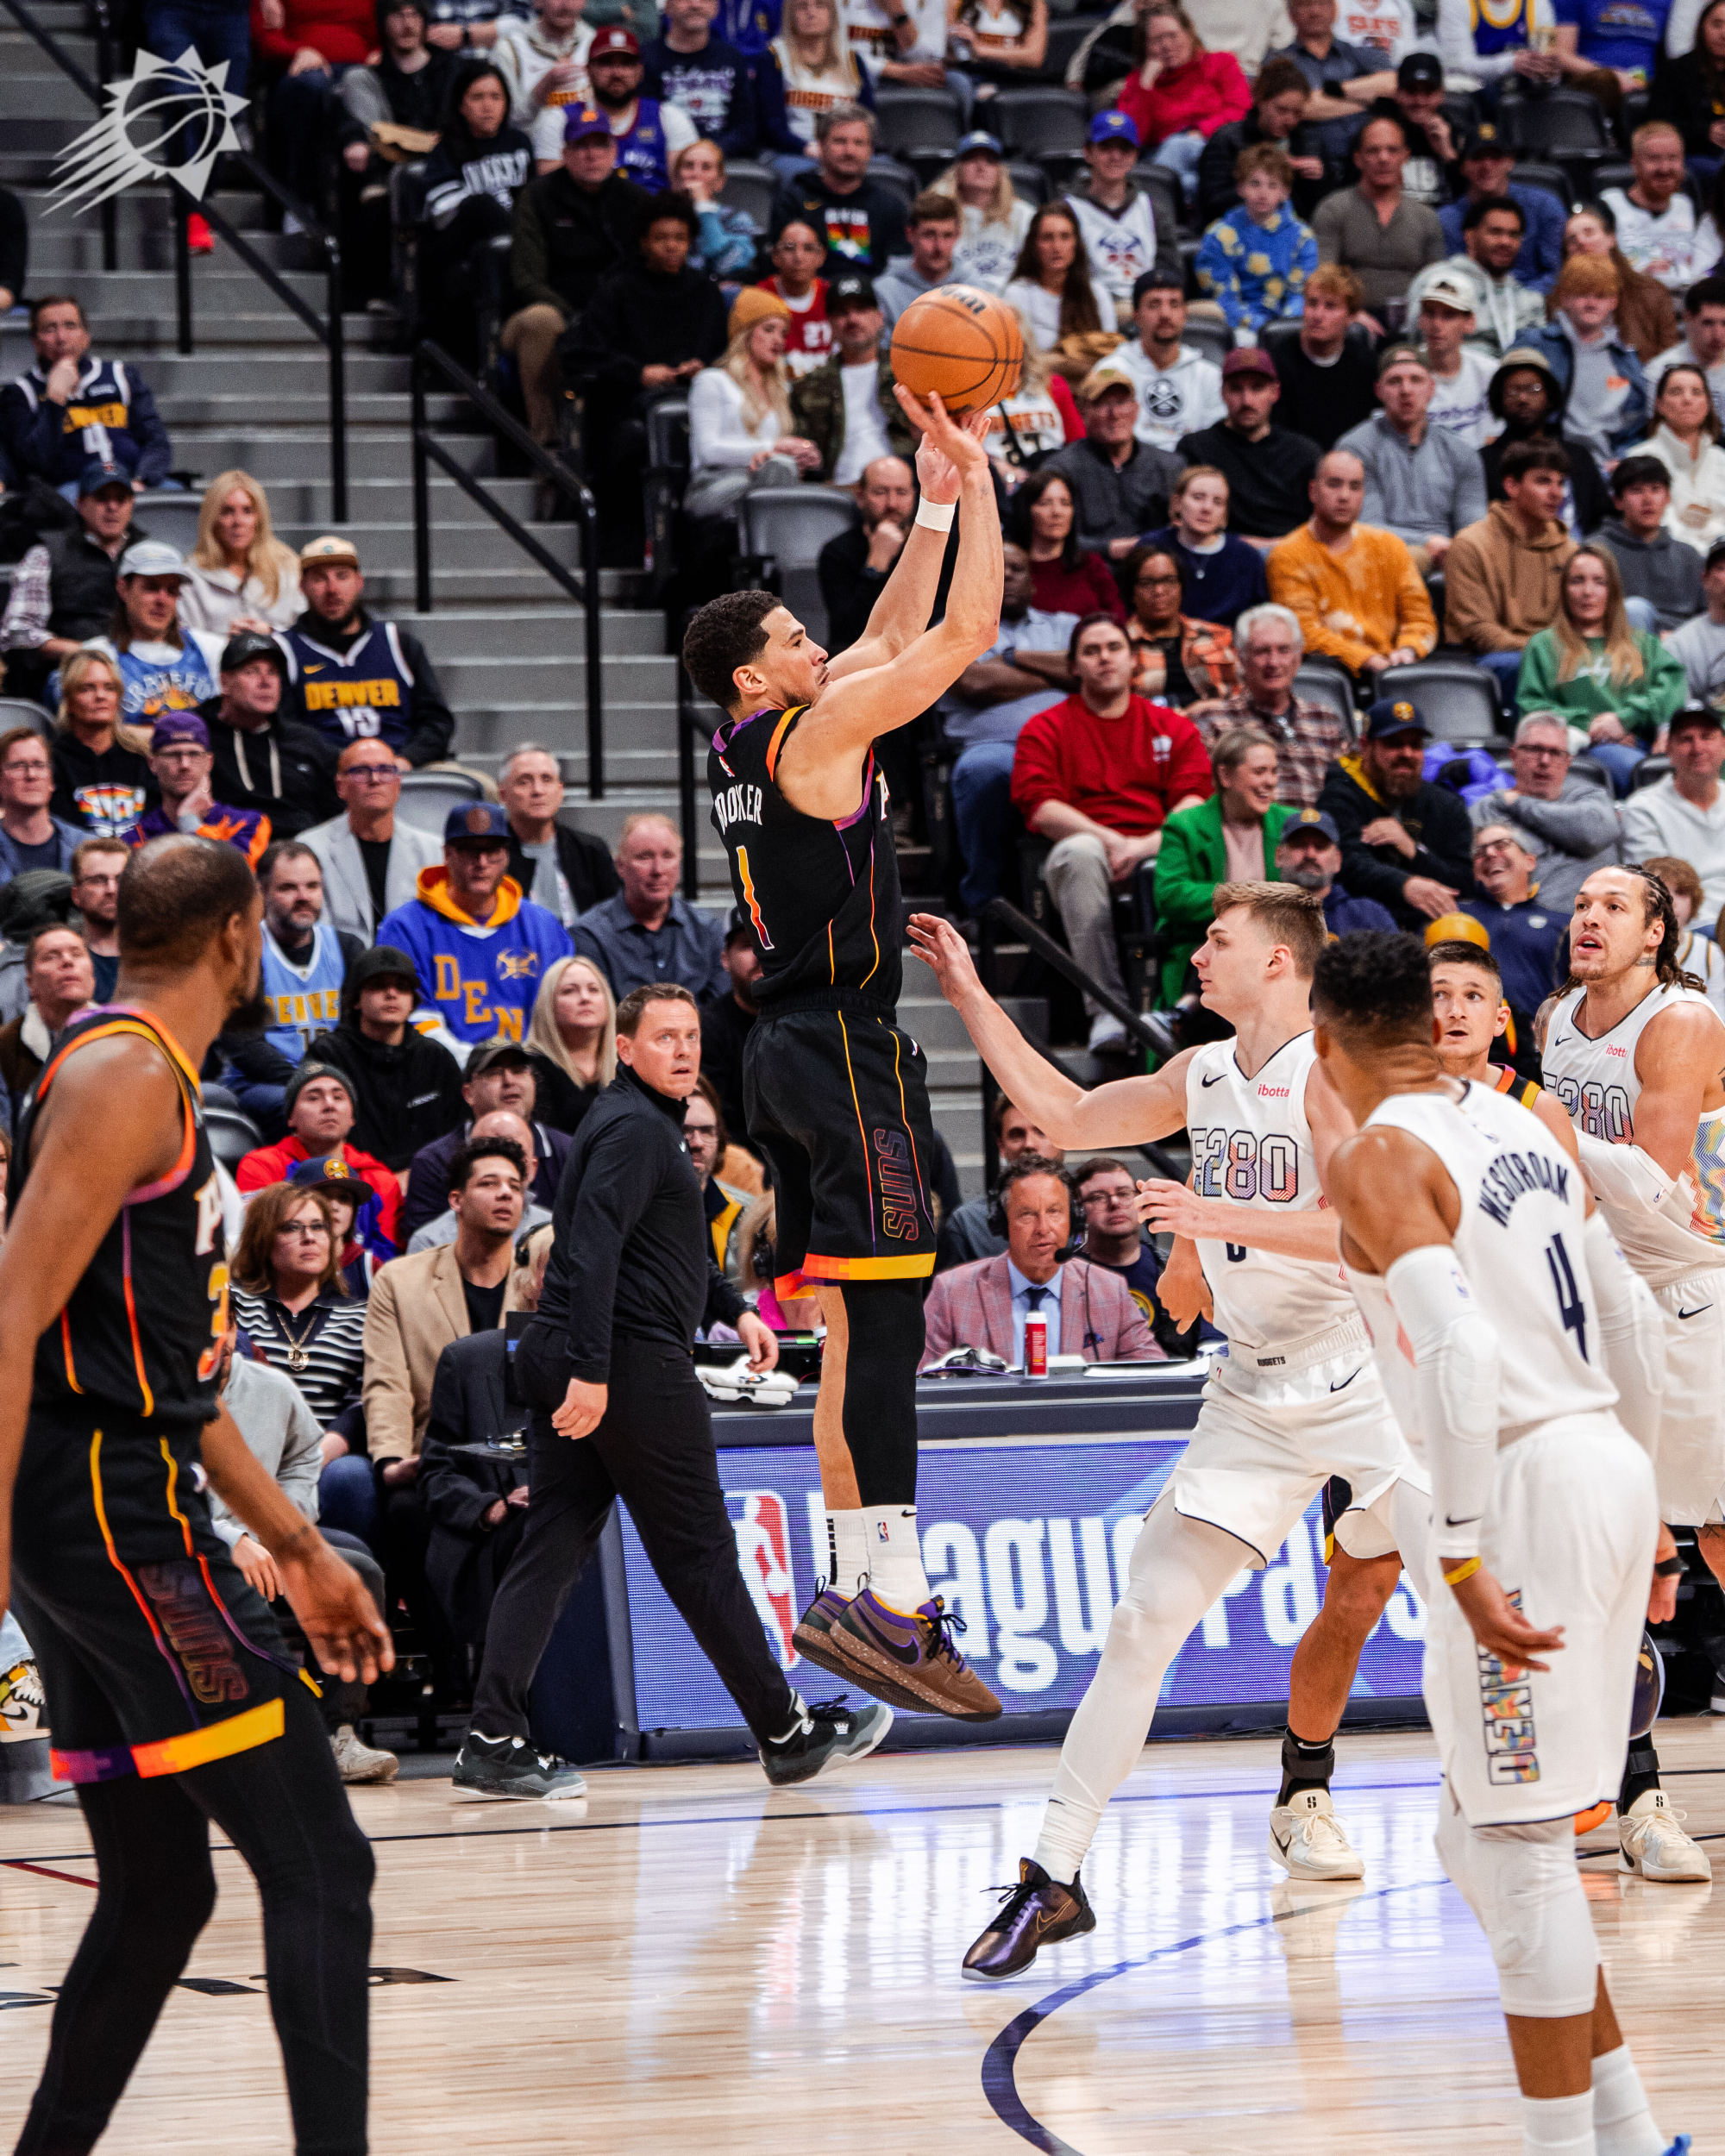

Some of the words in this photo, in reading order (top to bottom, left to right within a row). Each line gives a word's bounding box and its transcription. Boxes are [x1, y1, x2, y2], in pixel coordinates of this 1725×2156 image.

[304, 678, 400, 711] DENVER
[714, 783, 763, 835] OOKER
[735, 844, 775, 951] 1
[1257, 1083, 1290, 1098] ibotta
[873, 1127, 919, 1241] SUNS
[1191, 1127, 1299, 1203] 5280
[1545, 1232, 1590, 1365] 4
